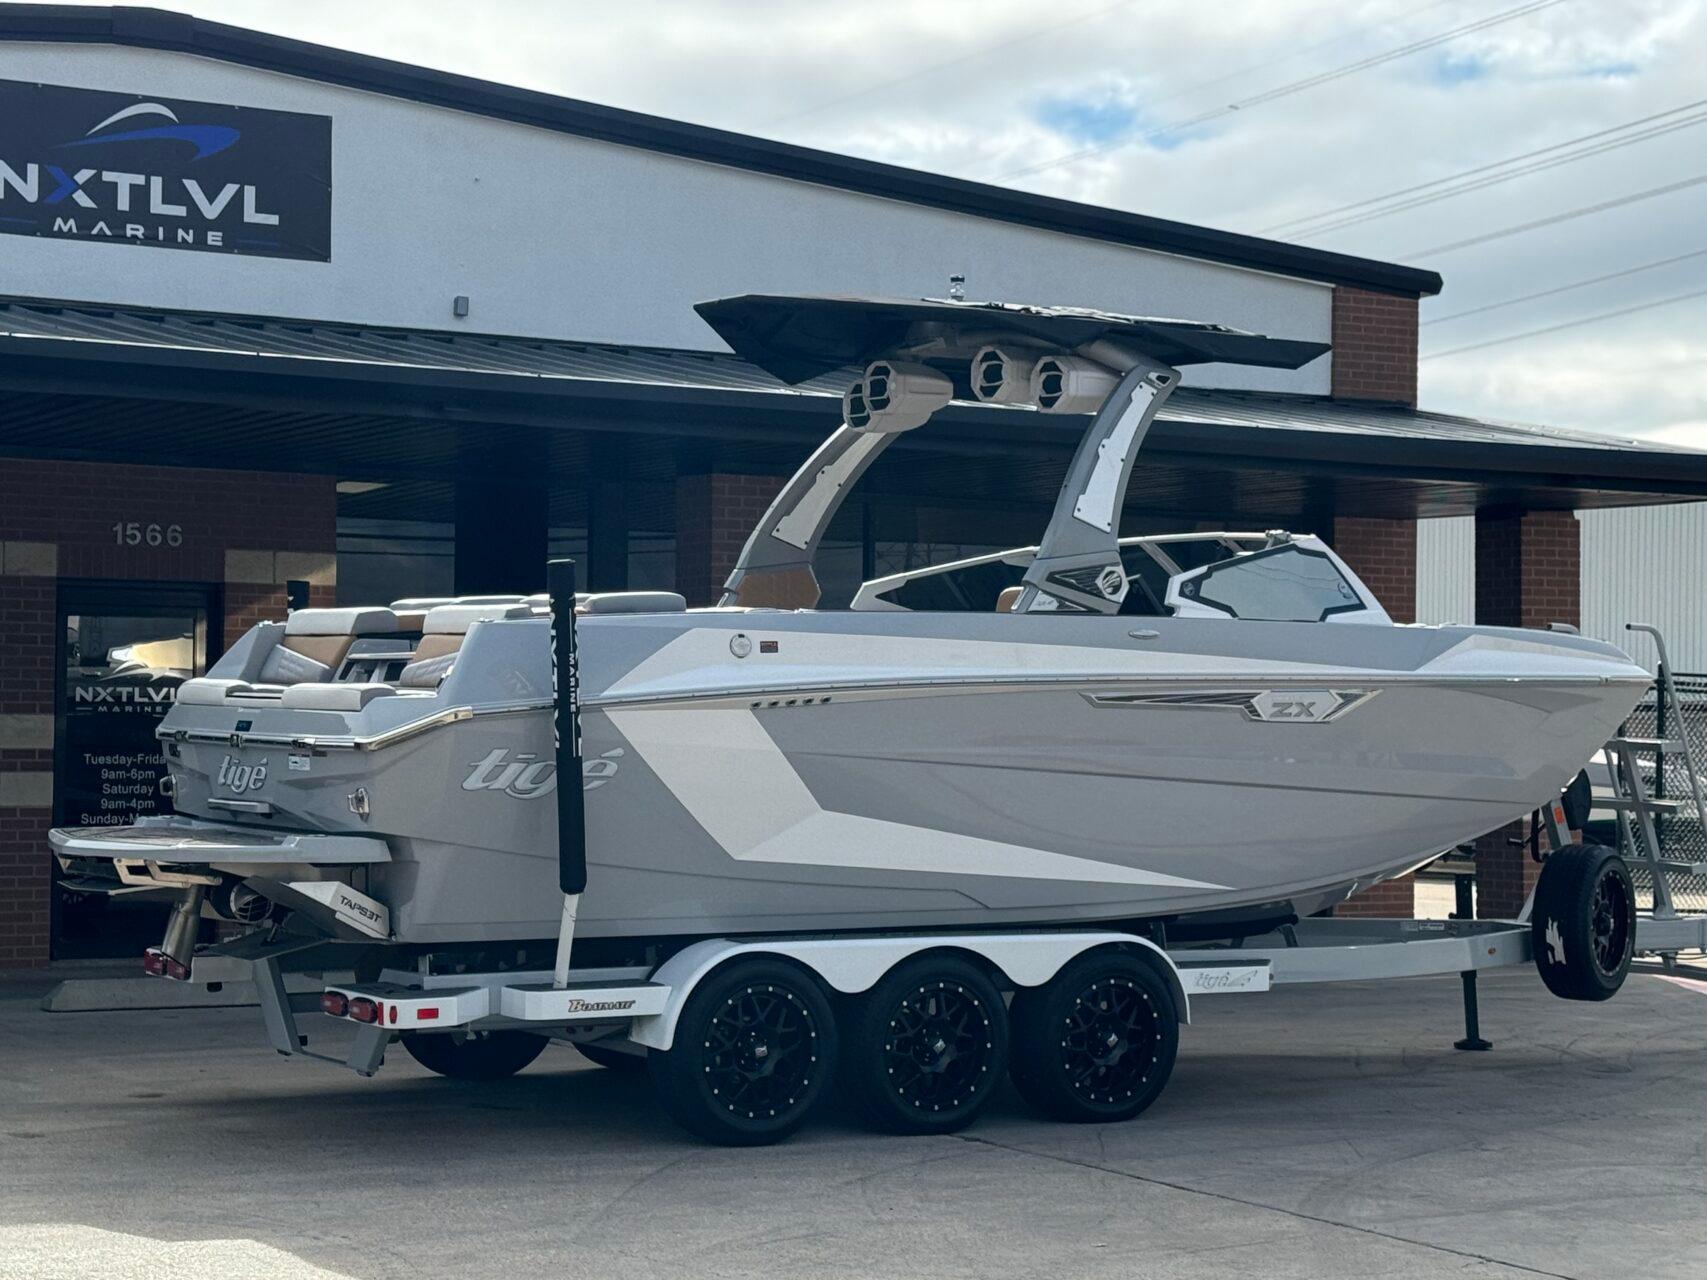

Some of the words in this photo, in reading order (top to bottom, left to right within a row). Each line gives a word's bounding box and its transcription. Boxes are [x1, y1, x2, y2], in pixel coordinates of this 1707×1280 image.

[0, 159, 280, 226] NXTLVL
[53, 216, 224, 246] MARINE
[112, 522, 183, 547] 1566
[568, 652, 577, 714] MARINE
[97, 705, 163, 713] MARINE
[1269, 701, 1316, 718] ZX
[83, 753, 167, 767] Tuesday-Frida
[101, 768, 156, 781] 9am-6pm
[217, 755, 269, 794] tigé
[102, 783, 154, 796] Saturday
[101, 798, 155, 811] 9am-4pm
